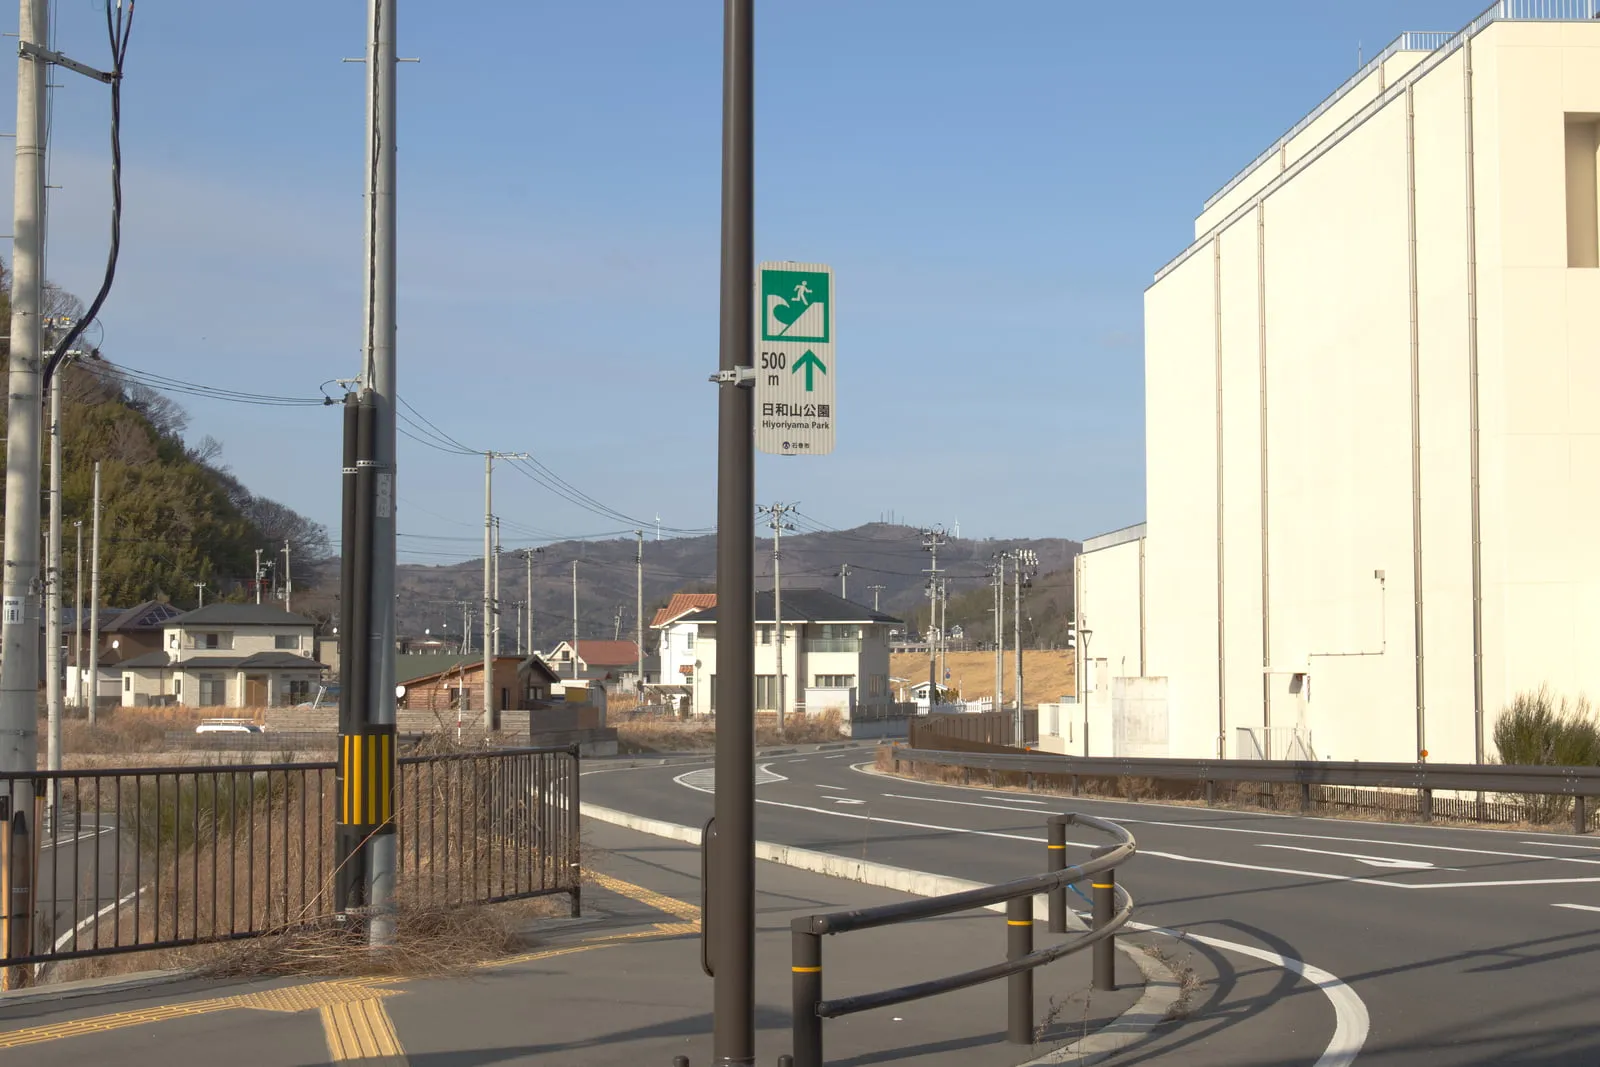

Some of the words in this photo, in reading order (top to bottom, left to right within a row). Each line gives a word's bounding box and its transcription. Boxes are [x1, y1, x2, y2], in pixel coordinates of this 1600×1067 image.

[761, 352, 786, 370] 500
[768, 374, 779, 386] m
[762, 403, 830, 418] 日和山公園
[762, 420, 810, 430] Hiyoriyama
[811, 421, 830, 430] Park
